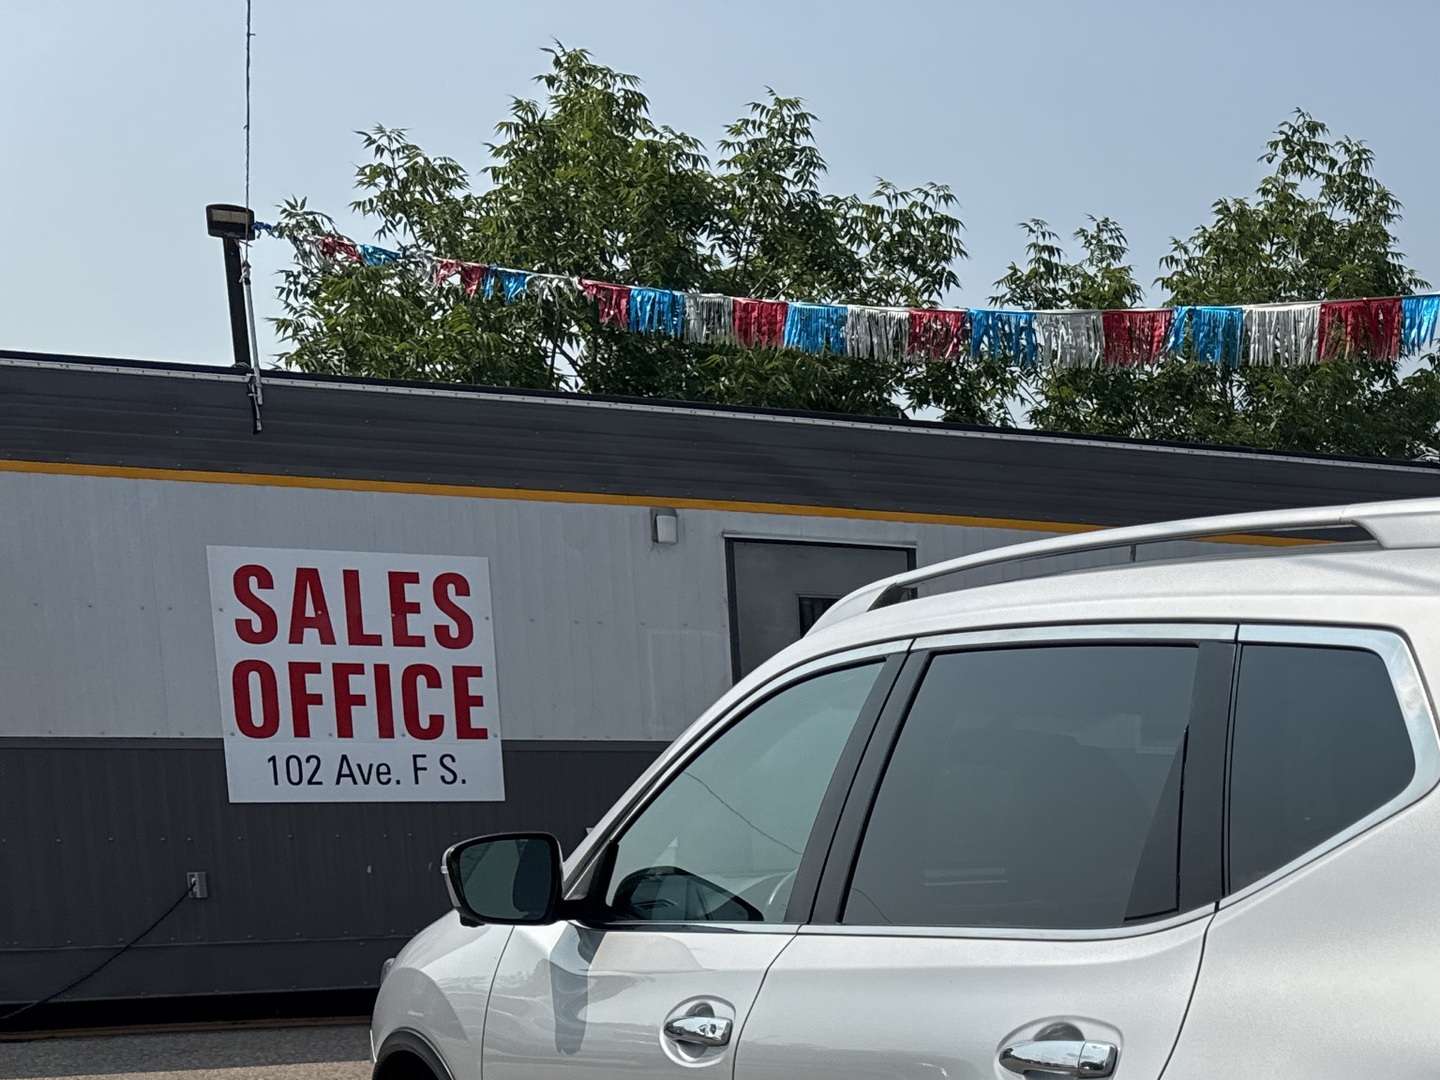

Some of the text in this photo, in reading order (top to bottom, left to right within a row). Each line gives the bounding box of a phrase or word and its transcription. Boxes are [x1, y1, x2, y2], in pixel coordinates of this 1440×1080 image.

[232, 564, 474, 650] SALES
[232, 659, 489, 740] OFFICE
[267, 753, 467, 786] 102 Ave. F S.
